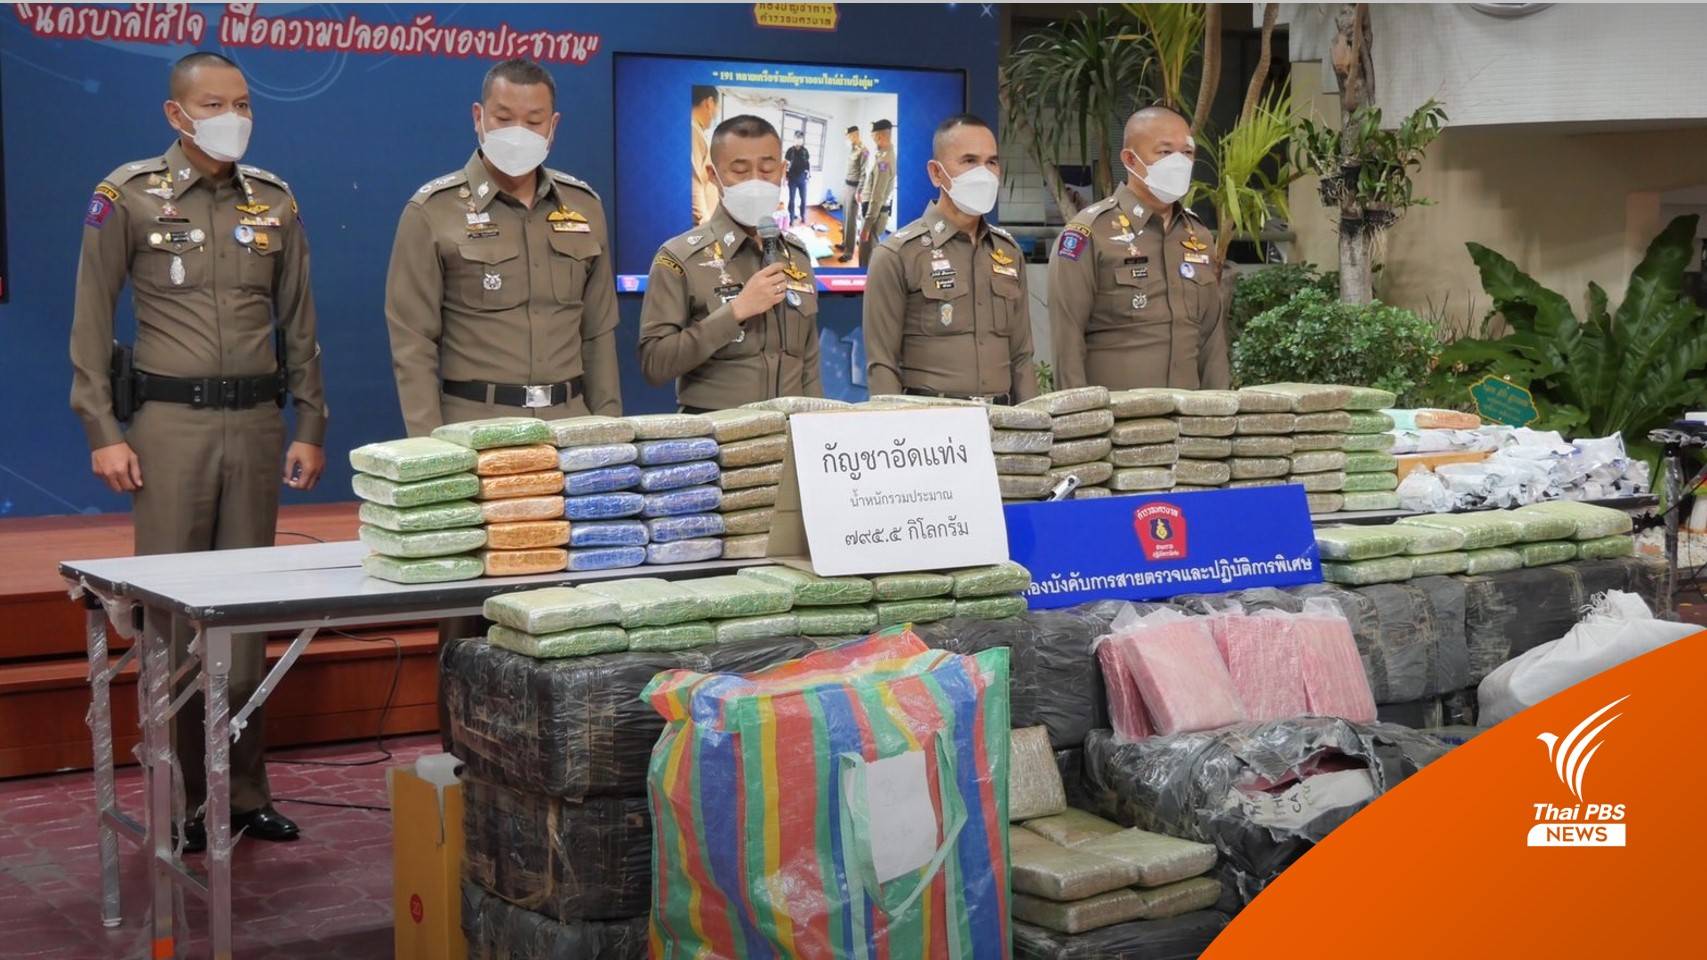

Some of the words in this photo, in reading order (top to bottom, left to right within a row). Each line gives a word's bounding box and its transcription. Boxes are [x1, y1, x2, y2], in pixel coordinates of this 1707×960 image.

[822, 436, 969, 480] กัญชาอัดแท่ง
[850, 488, 953, 507] น้ำหนักรวมประมาณ
[845, 526, 902, 546] ๗๙๕.๕
[907, 514, 969, 540] กิโลกรัม
[1021, 555, 1313, 597] องบังคับการสายตรวจและปฏิบัติการพิเศษ
